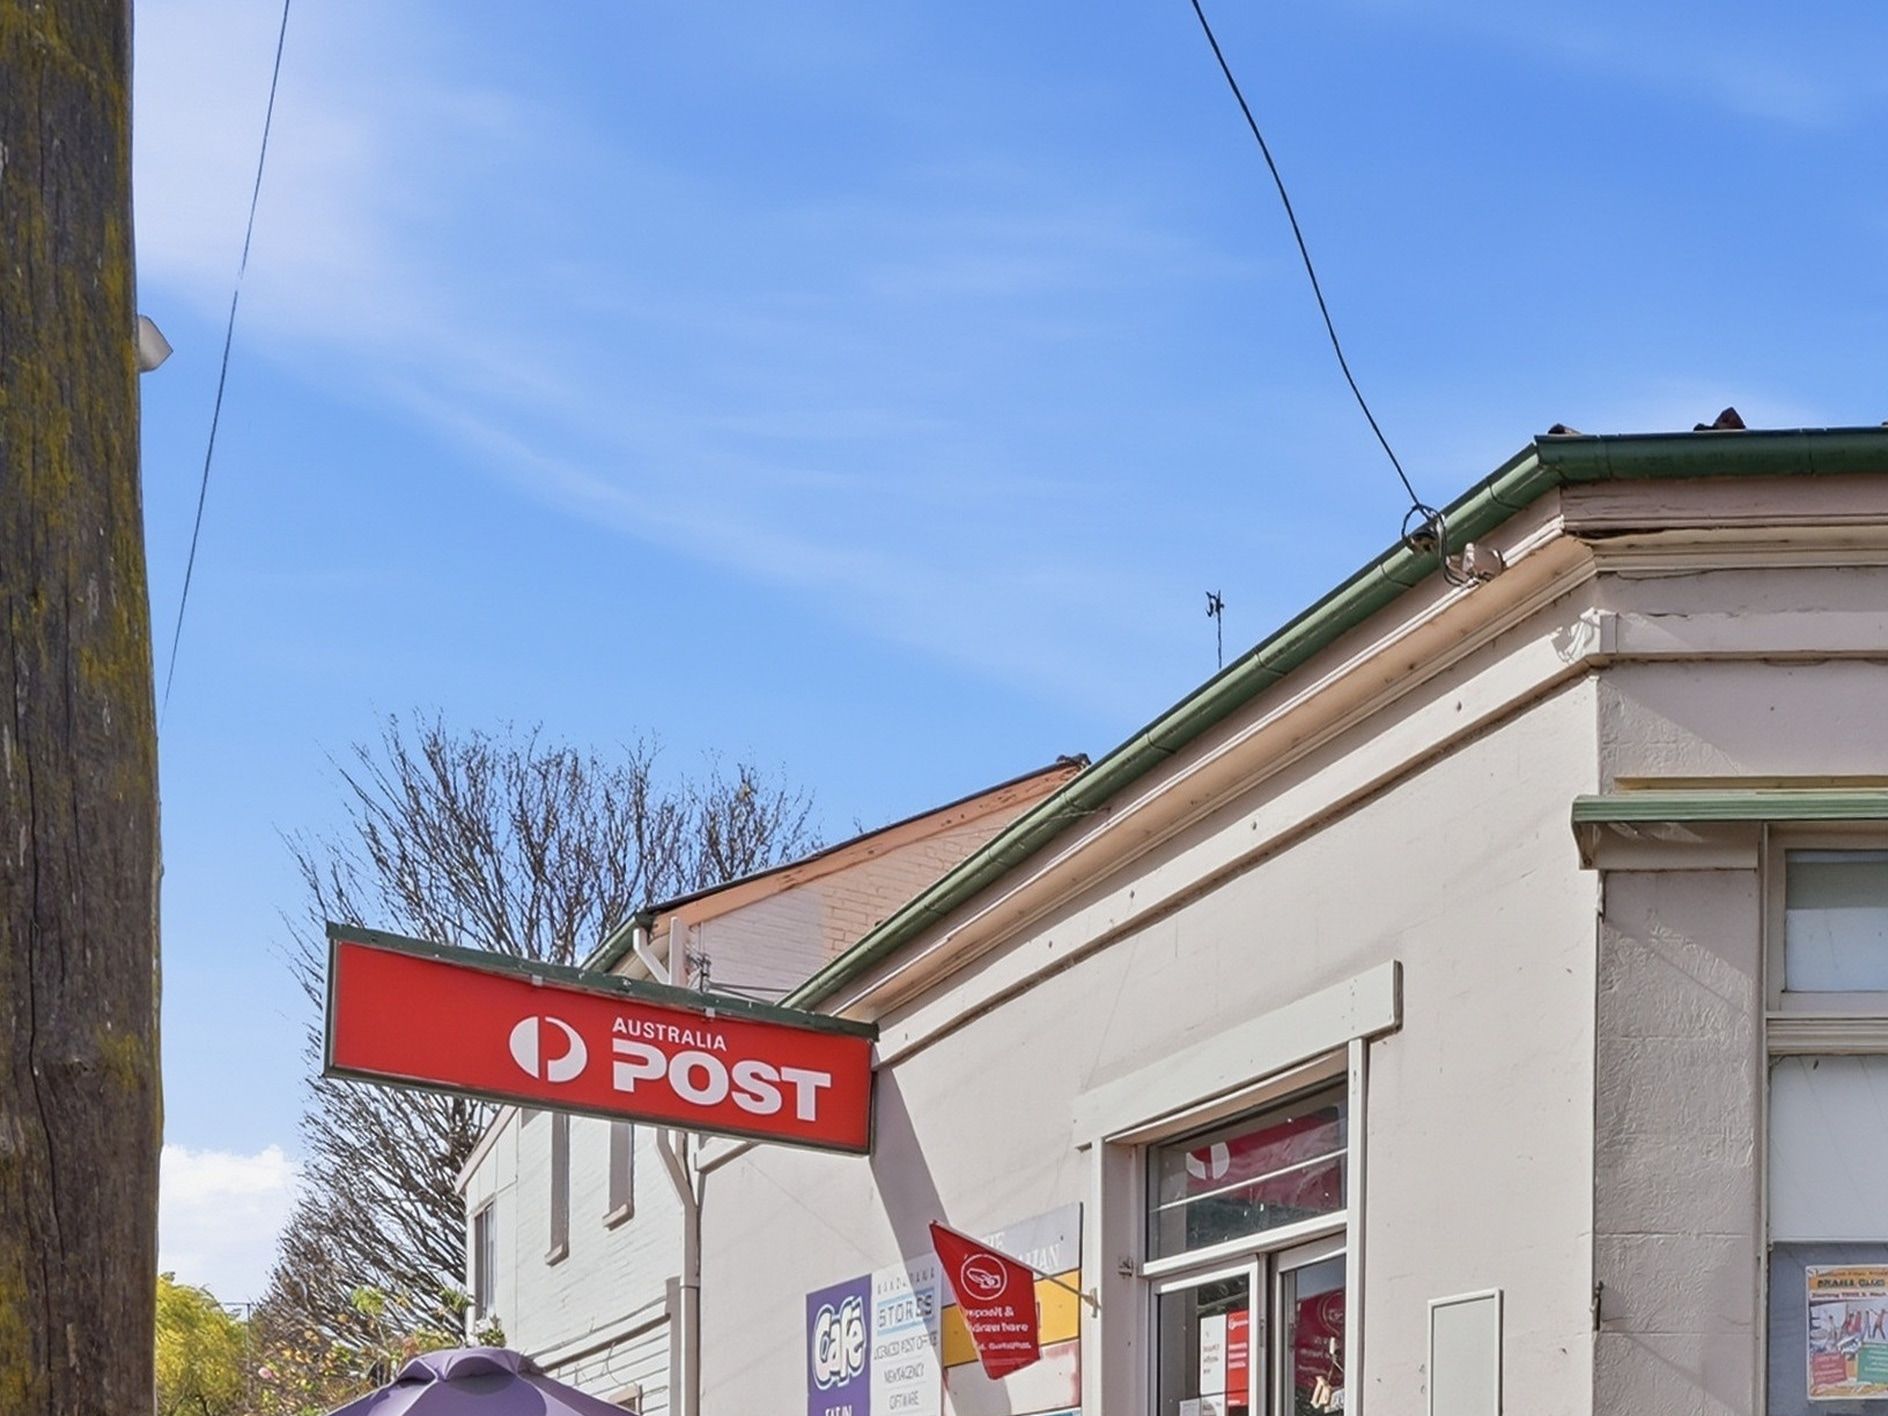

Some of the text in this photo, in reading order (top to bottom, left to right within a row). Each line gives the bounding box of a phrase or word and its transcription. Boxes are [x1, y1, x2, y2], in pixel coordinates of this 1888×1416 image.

[612, 1017, 727, 1051] AUSTRALIA
[612, 1038, 831, 1121] POST
[879, 1294, 933, 1328] STORES
[813, 1296, 867, 1389] Café
